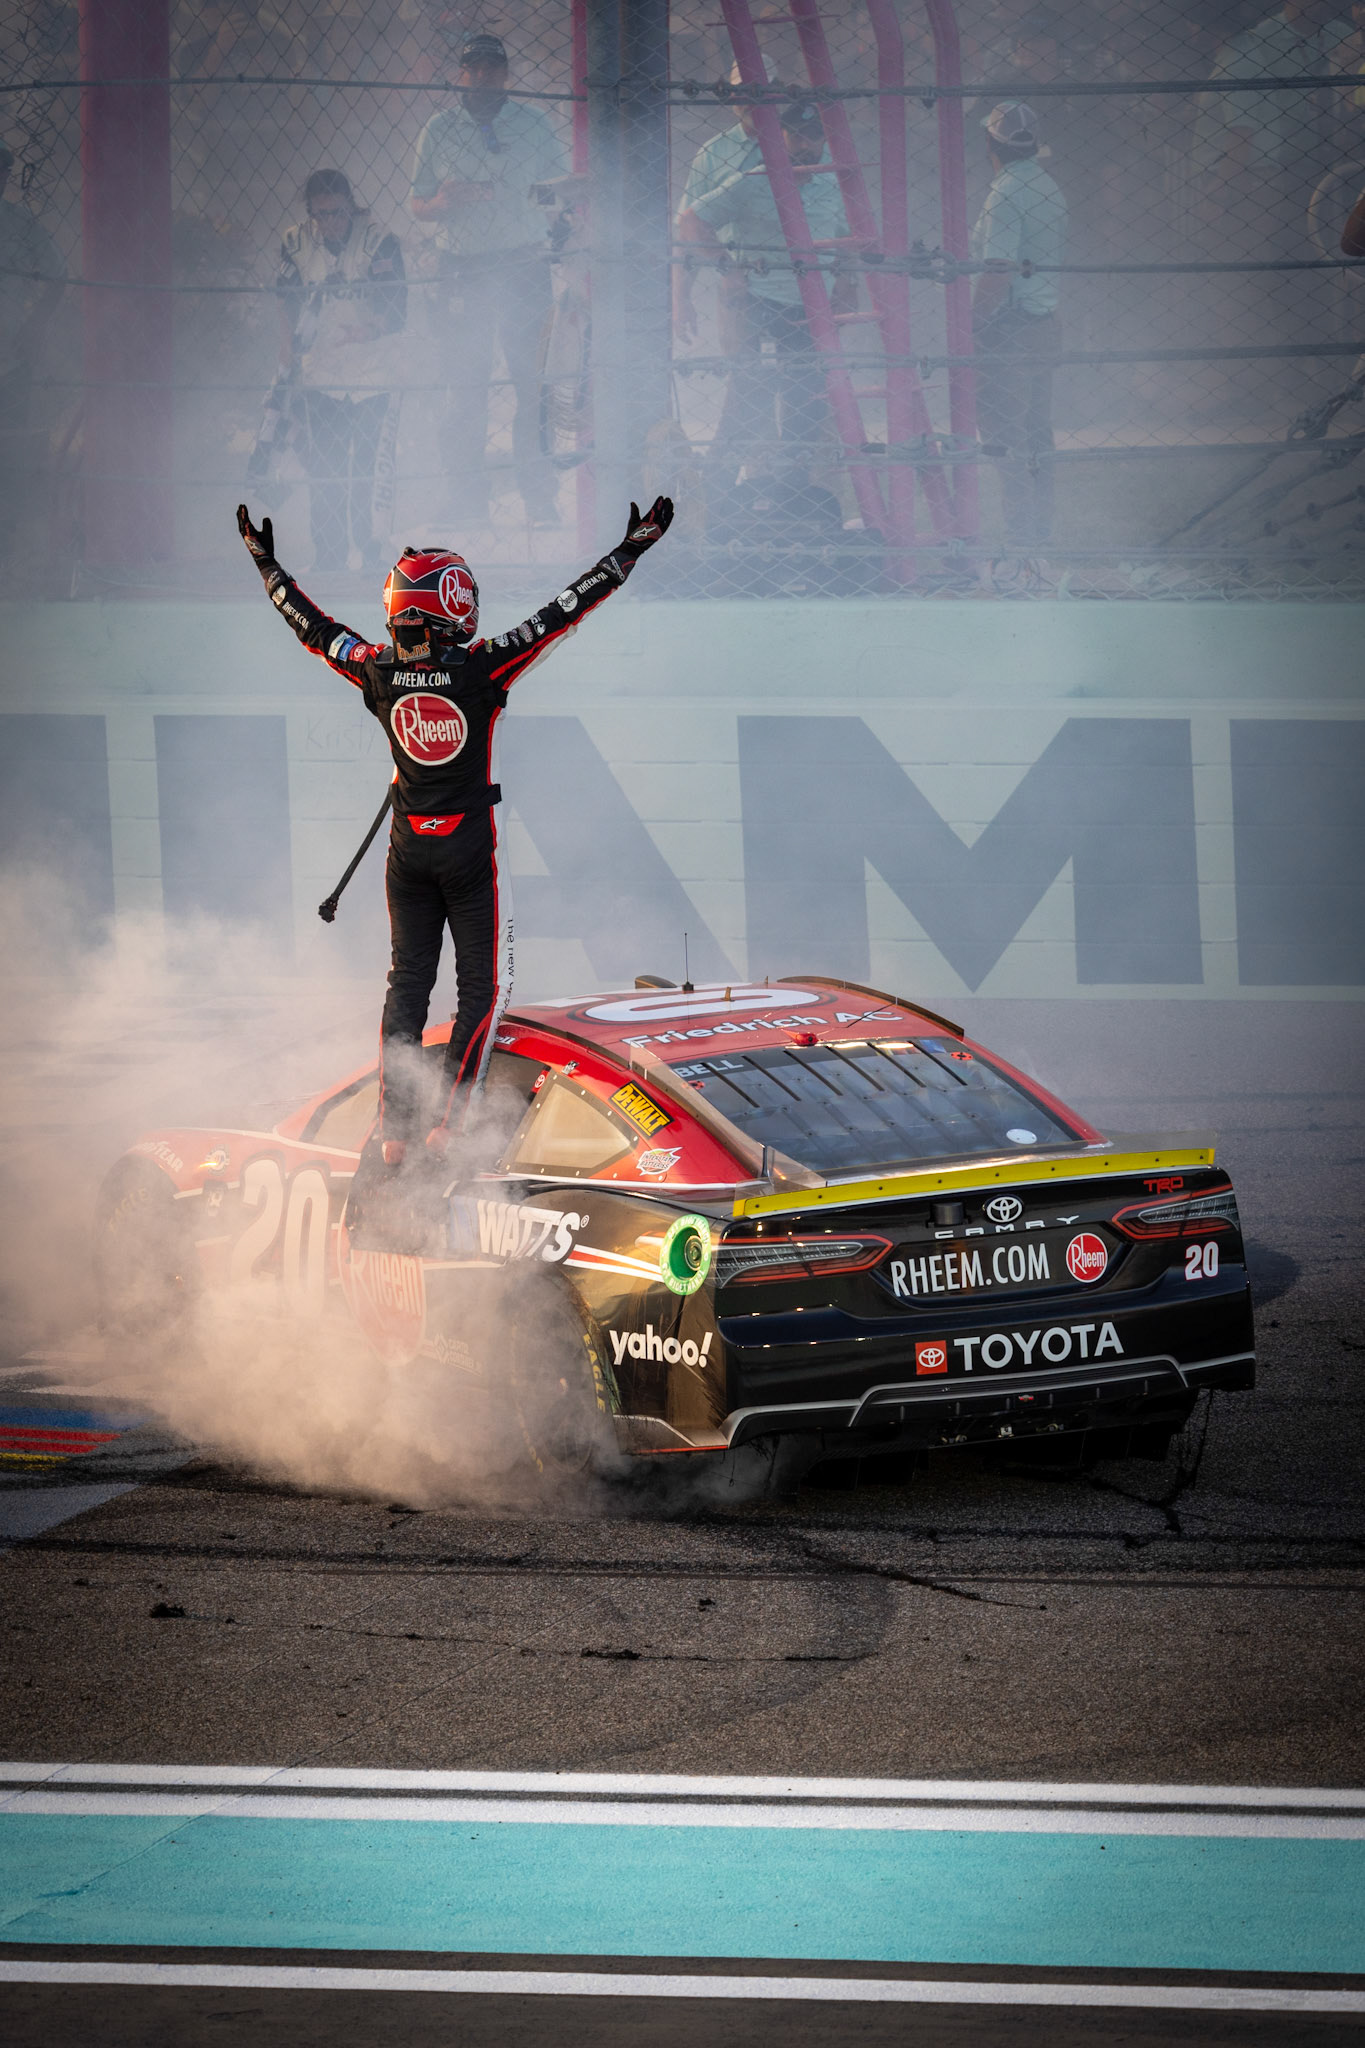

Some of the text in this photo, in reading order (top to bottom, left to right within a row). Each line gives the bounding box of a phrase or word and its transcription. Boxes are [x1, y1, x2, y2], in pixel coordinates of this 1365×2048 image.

[392, 671, 452, 688] RHEEM.COM
[399, 696, 462, 752] Rheem
[621, 1010, 904, 1048] Friedrich AC
[672, 1059, 744, 1079] BELL
[613, 1087, 665, 1133] DEWALT
[1143, 1176, 1184, 1195] TRD
[234, 1158, 330, 1317] 20
[934, 1215, 1080, 1239] CAMRY
[890, 1243, 1051, 1297] RHEEM.COM
[1071, 1235, 1105, 1275] Rheem
[1184, 1241, 1219, 1281] 20
[609, 1323, 713, 1368] yahoo!
[953, 1321, 1125, 1372] TOYOTA
[583, 1333, 606, 1413] EAGLE
